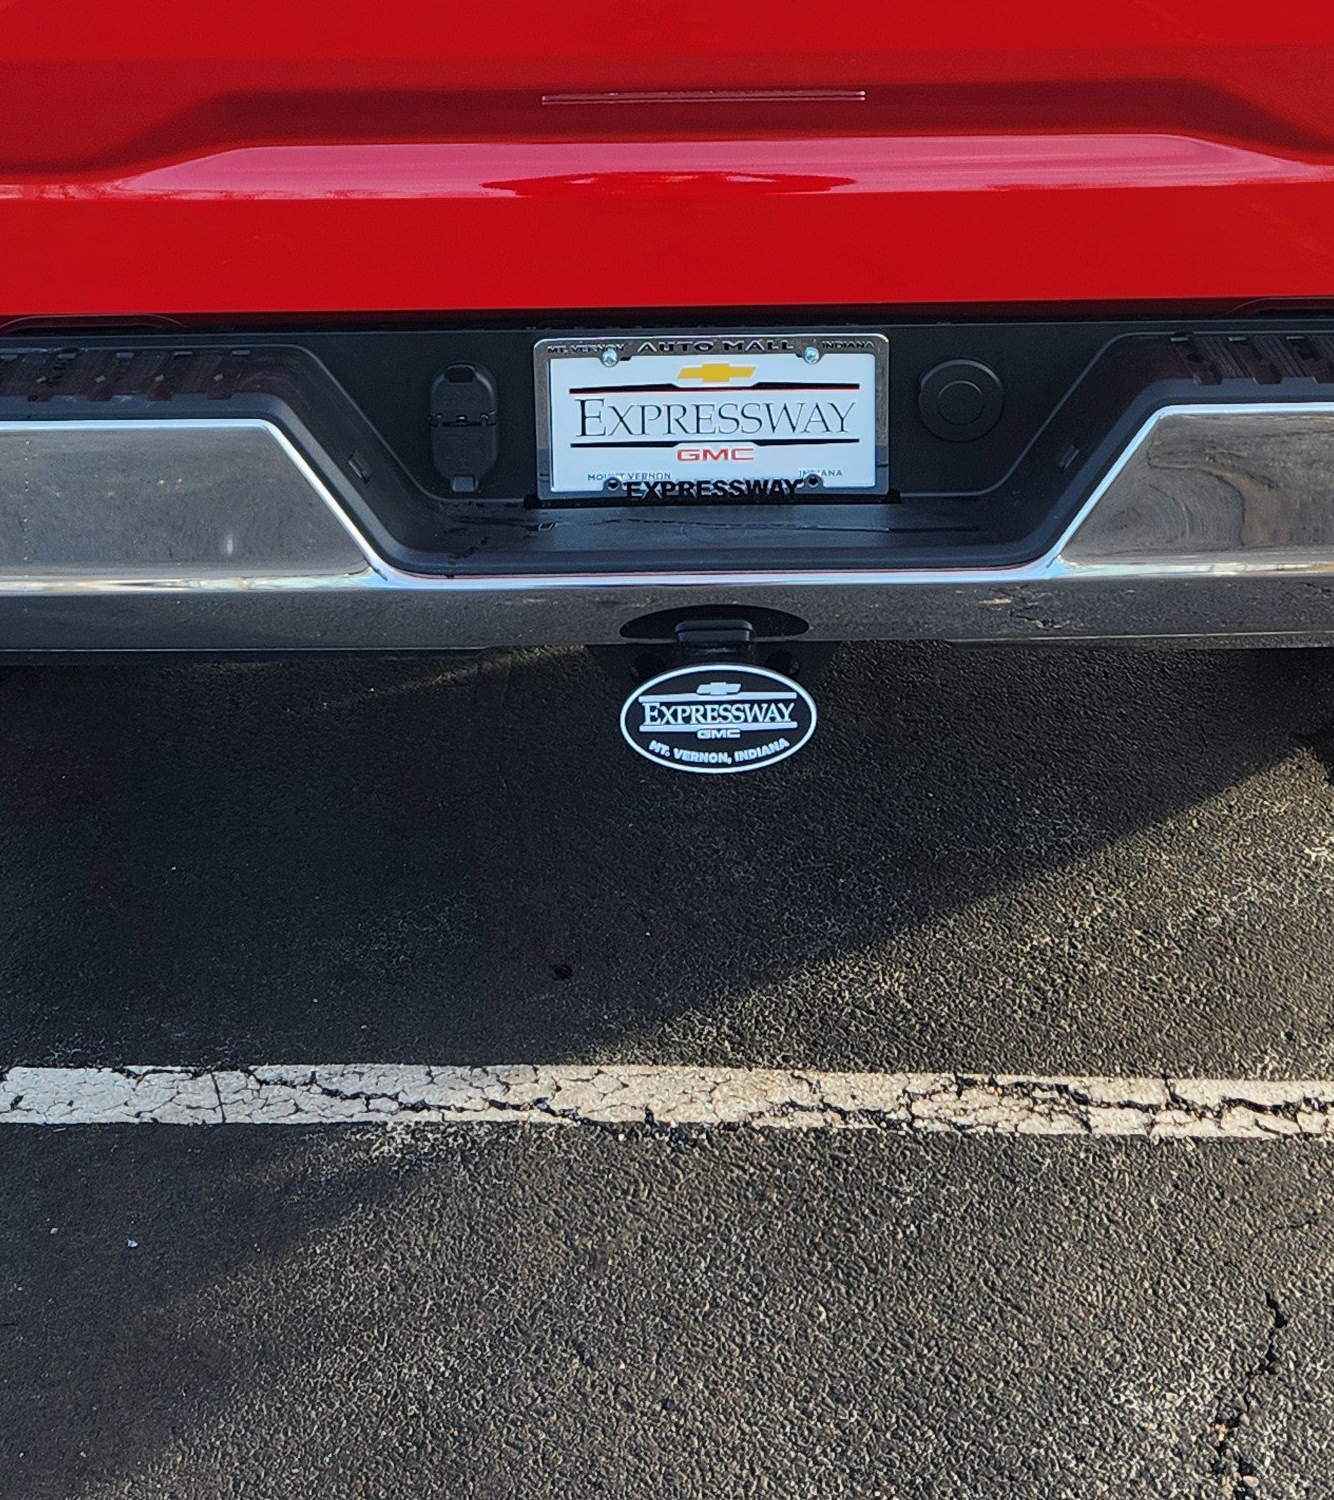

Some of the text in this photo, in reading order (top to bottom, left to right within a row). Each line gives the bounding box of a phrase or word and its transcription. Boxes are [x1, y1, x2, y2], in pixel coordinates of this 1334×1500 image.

[637, 341, 715, 353] AUTO
[722, 339, 794, 351] MALL
[821, 340, 875, 349] INDIANA
[574, 398, 857, 438] EXPRESSWAY
[676, 448, 755, 461] GMC
[799, 469, 843, 478] INANA
[624, 478, 804, 499] EXPRESSWAY
[642, 701, 795, 725] EXPRESSWAY
[696, 729, 741, 739] GMC
[734, 737, 790, 762] INDIANA
